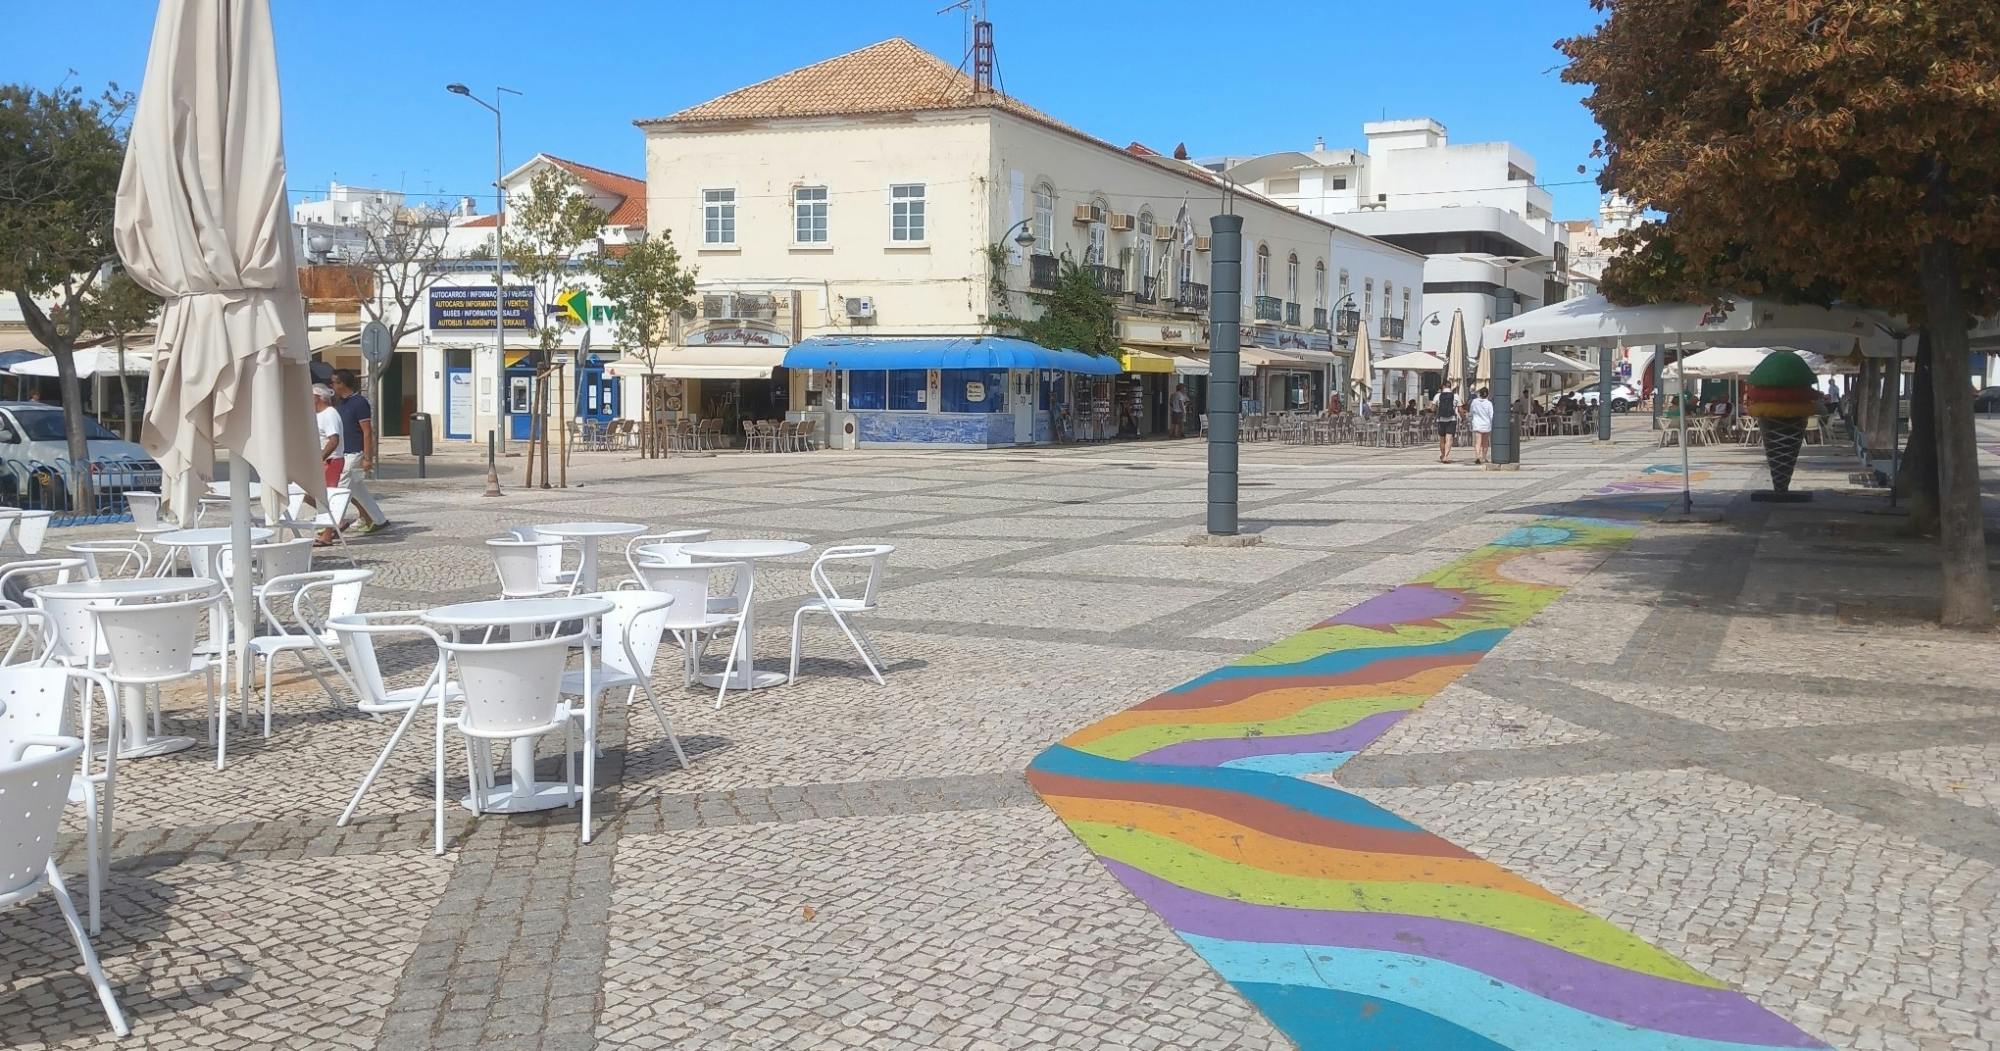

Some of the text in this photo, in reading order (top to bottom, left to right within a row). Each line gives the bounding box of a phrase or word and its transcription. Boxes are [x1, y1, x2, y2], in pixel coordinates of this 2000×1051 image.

[503, 309, 520, 317] SALES
[704, 329, 769, 345] Casa Inglesa
[1161, 326, 1182, 340] Casa
